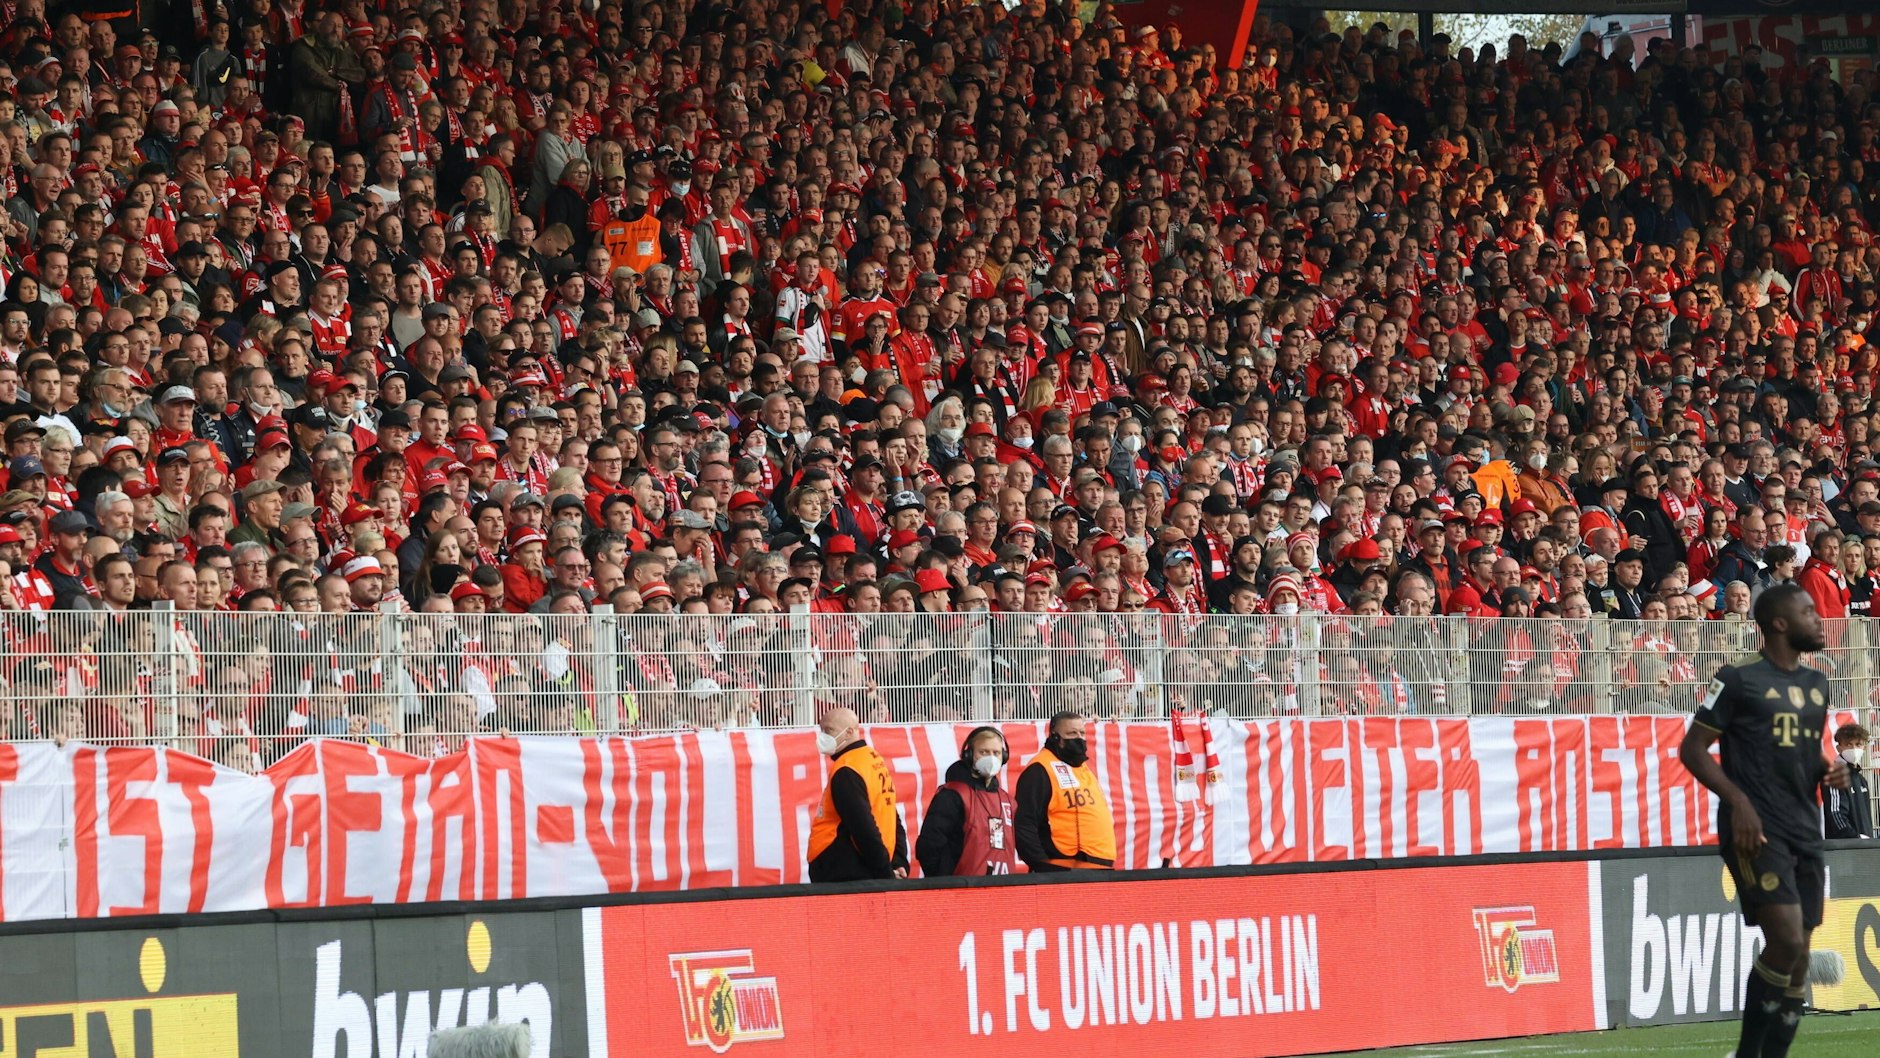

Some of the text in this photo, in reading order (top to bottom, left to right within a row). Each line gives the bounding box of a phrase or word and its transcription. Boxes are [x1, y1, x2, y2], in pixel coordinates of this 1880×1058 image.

[1822, 37, 1869, 51] BERLINER
[609, 241, 628, 256] 77
[1063, 788, 1095, 810] 163
[1244, 718, 1483, 864] WEITER
[1002, 928, 1051, 1032] FC
[1058, 922, 1183, 1029] UNION
[1190, 914, 1321, 1019] BERLIN
[734, 987, 779, 1031] UNION
